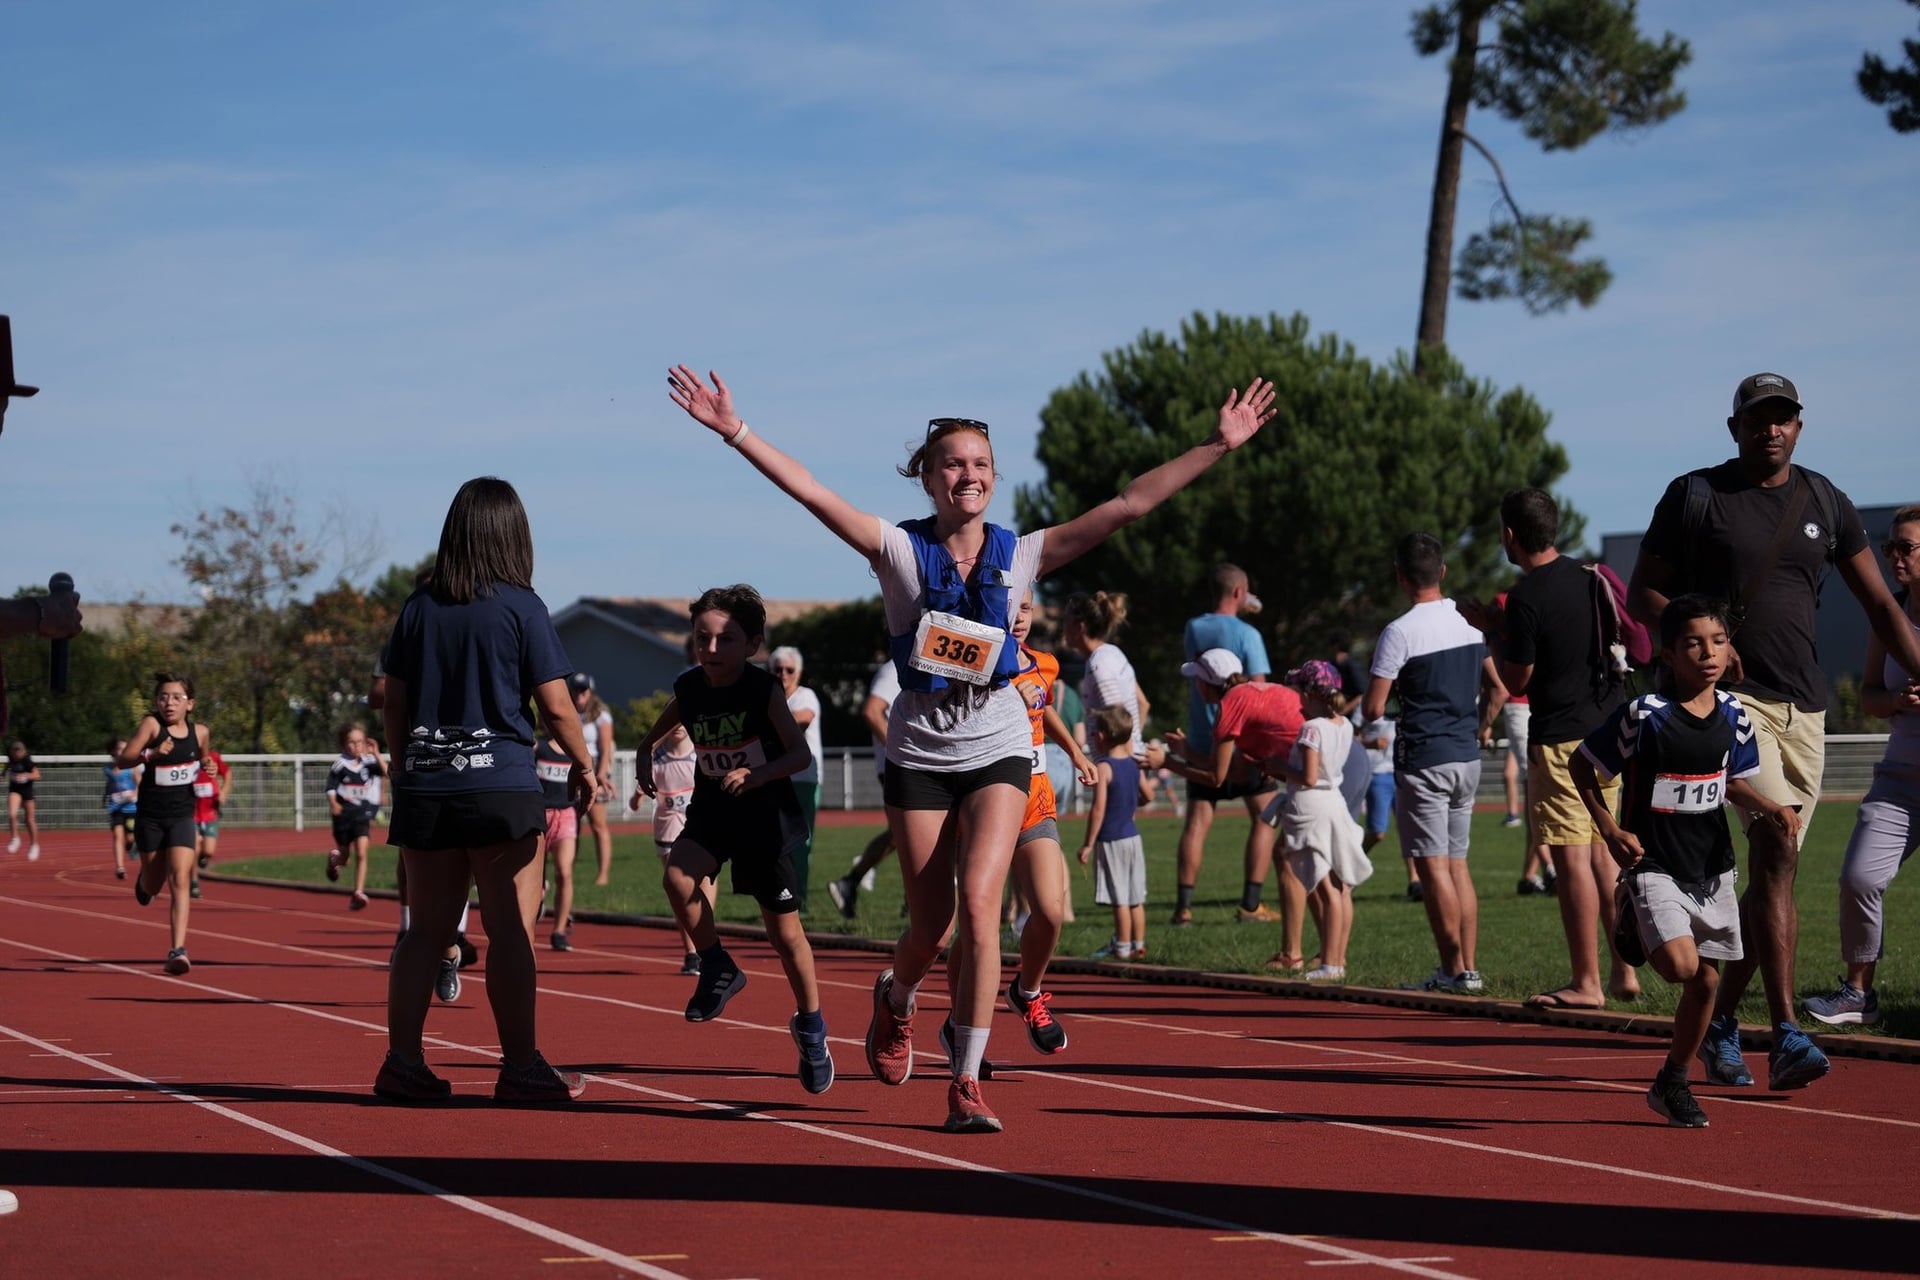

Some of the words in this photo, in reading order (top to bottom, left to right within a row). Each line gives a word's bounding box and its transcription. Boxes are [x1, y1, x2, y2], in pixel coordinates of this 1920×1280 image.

[933, 635, 980, 664] 336
[914, 661, 984, 684] www.protiming.fr
[692, 711, 748, 744] PLAY
[545, 765, 569, 778] 135
[702, 751, 751, 771] 102
[169, 768, 189, 782] 95
[665, 795, 685, 809] 93
[1673, 782, 1719, 804] 119
